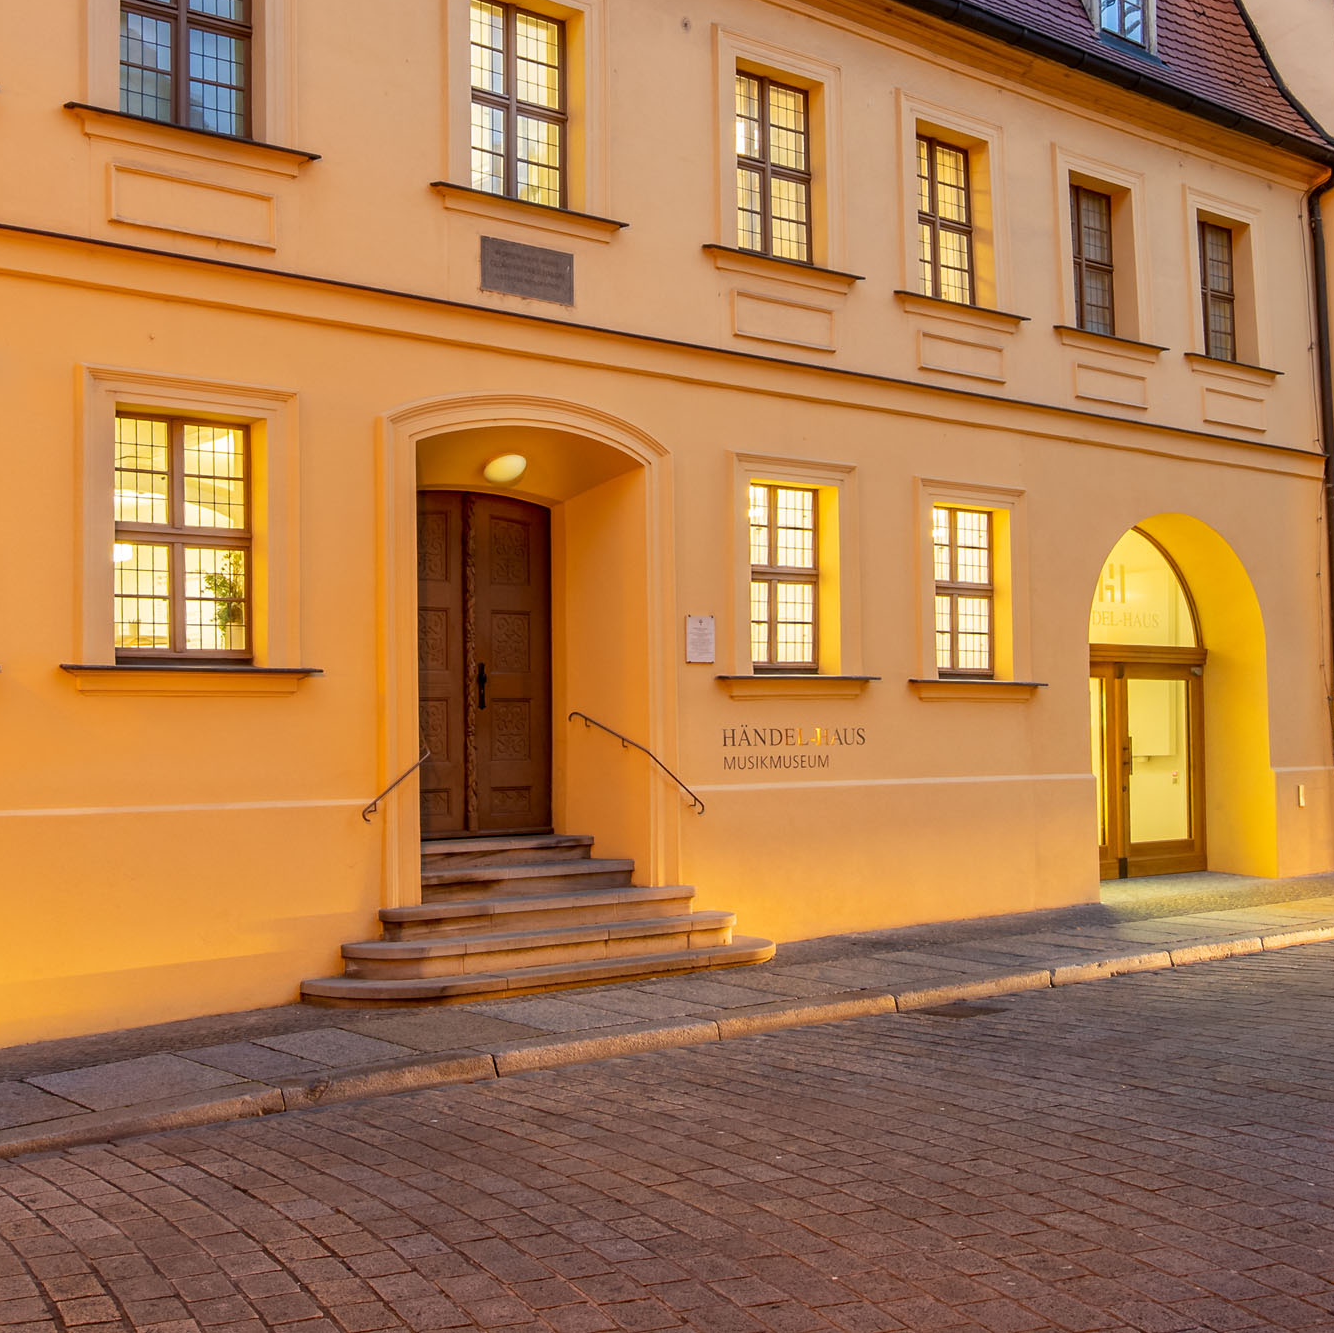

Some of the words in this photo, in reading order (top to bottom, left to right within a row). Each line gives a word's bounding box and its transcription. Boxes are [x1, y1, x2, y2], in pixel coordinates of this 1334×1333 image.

[1091, 610, 1160, 627] DEL-HAUS
[722, 724, 866, 747] HÄNDEL-HAUS
[723, 754, 829, 770] MUSIKMUSEUM
